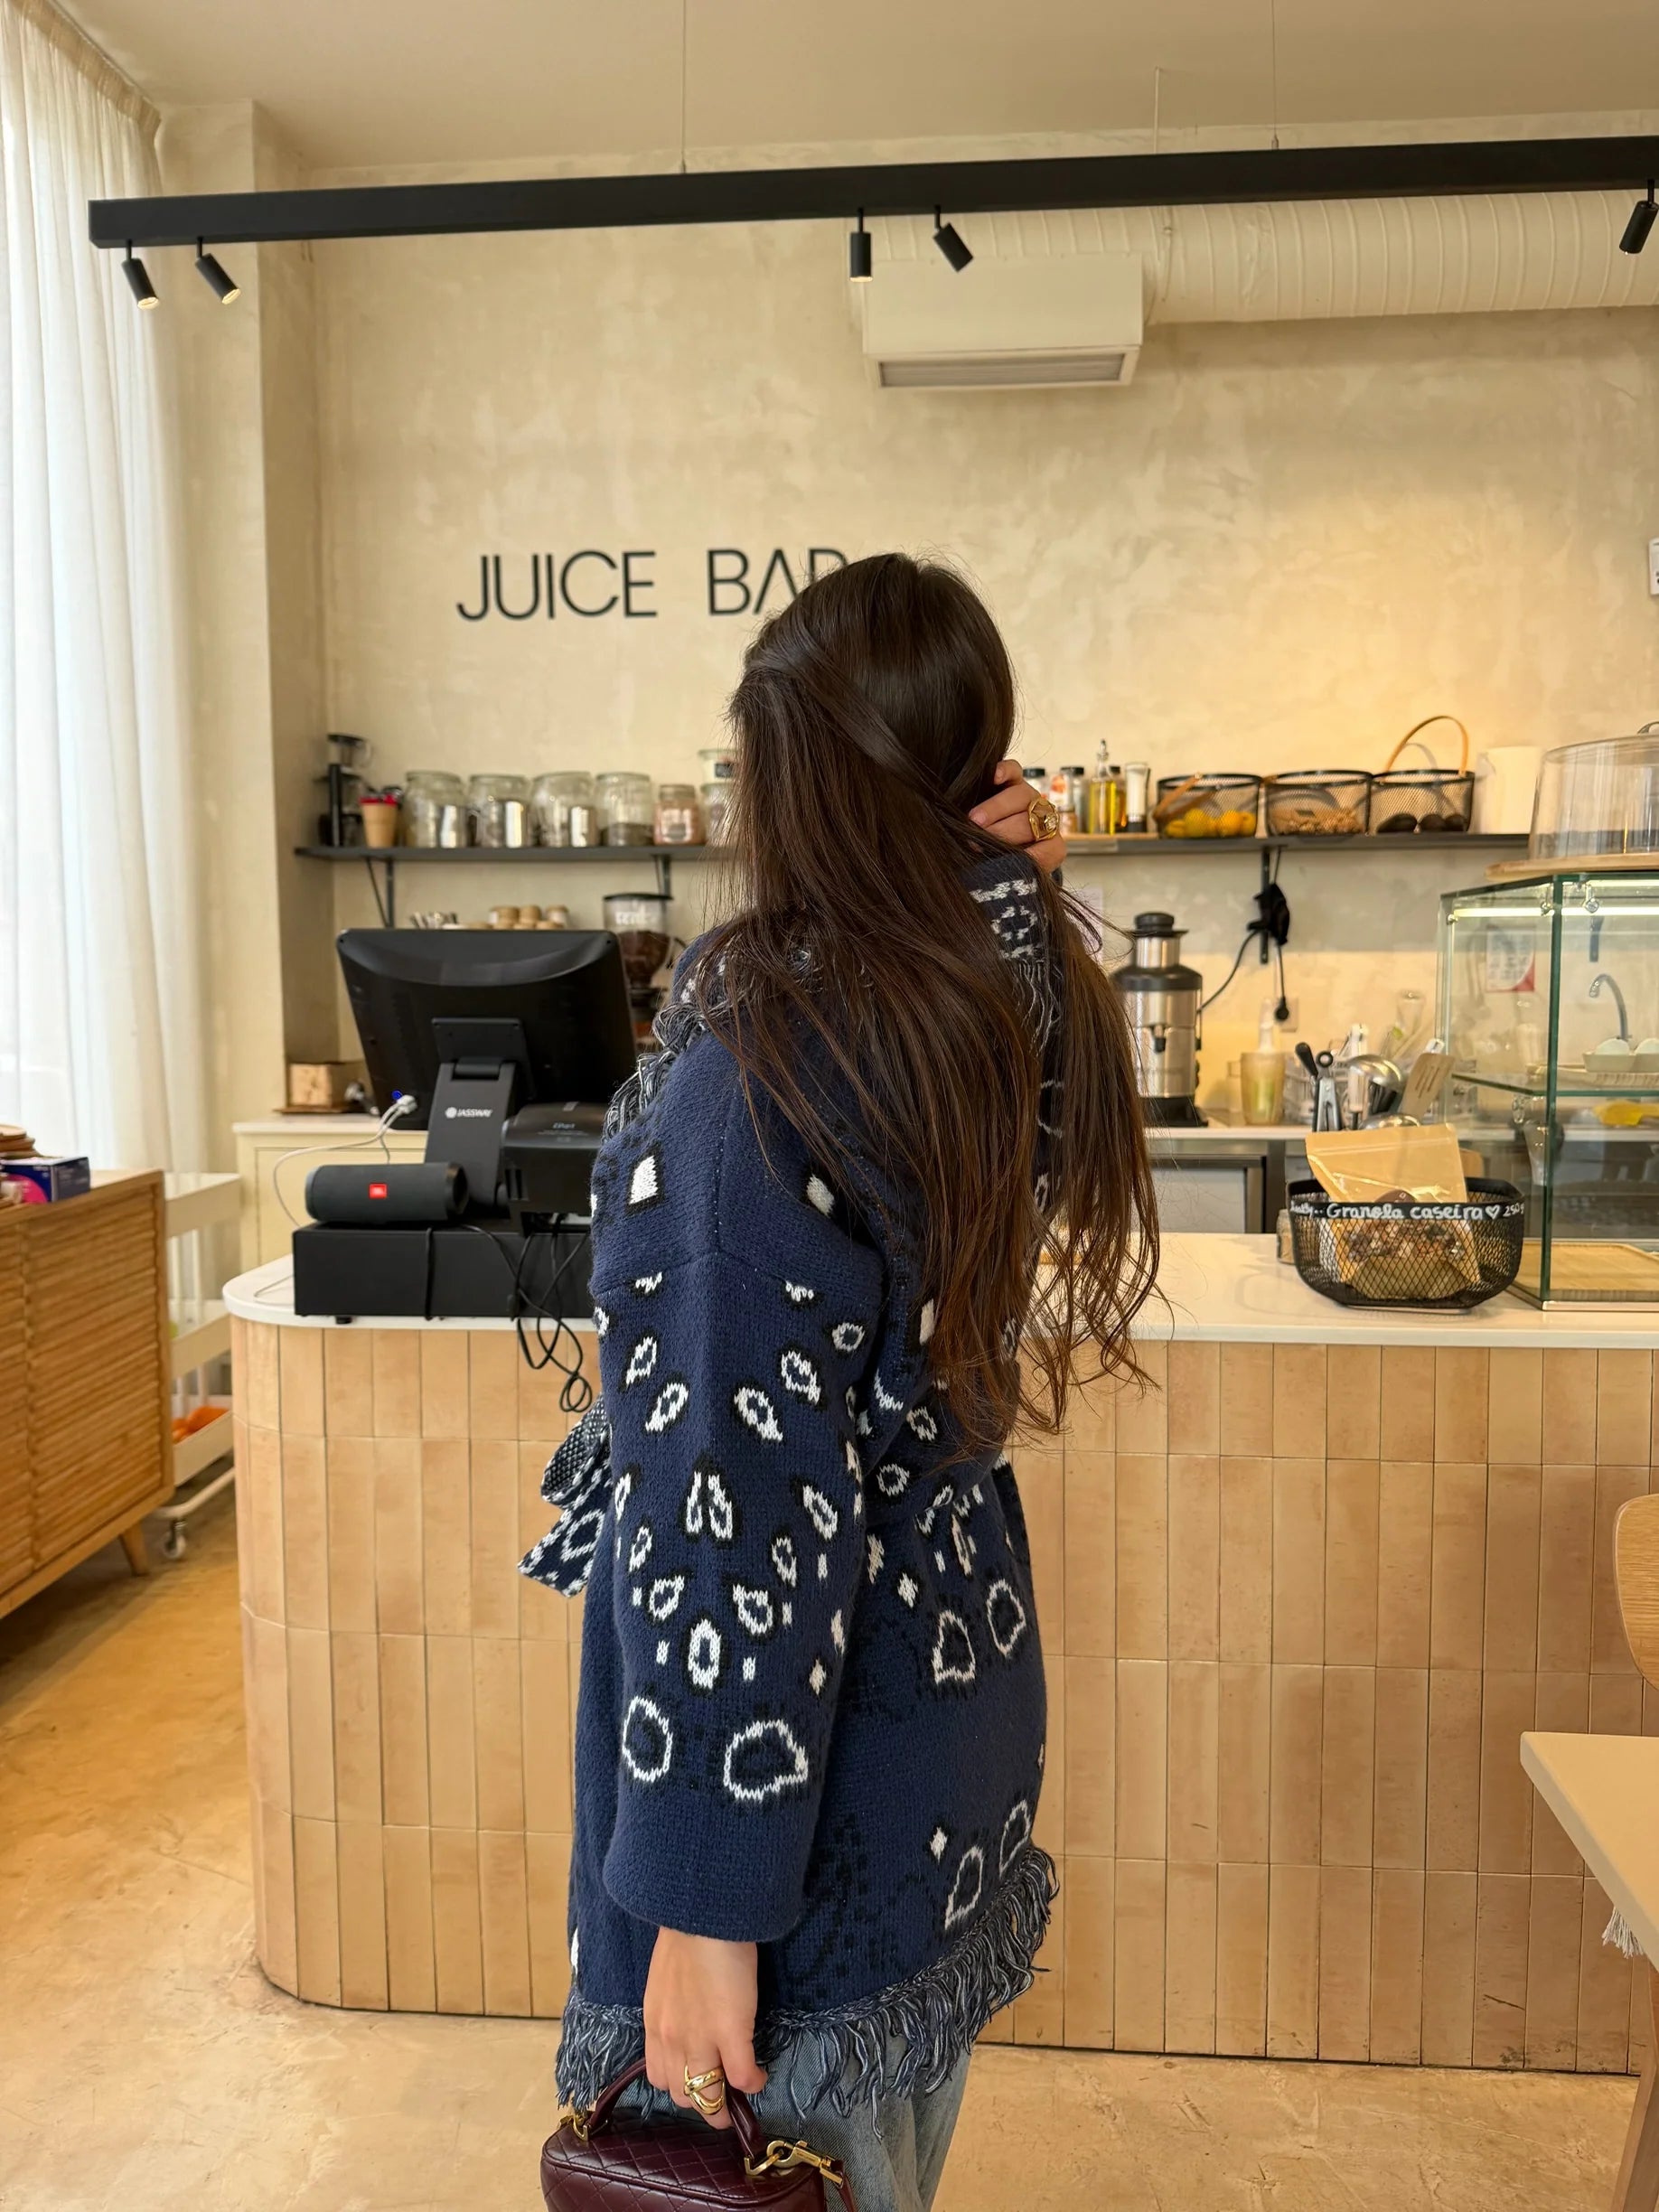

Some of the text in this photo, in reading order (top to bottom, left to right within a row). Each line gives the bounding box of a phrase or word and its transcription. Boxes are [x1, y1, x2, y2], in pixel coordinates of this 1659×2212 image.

[455, 549, 658, 622] JUICE
[1326, 1203, 1404, 1220] Granola
[1410, 1204, 1484, 1221] caseira
